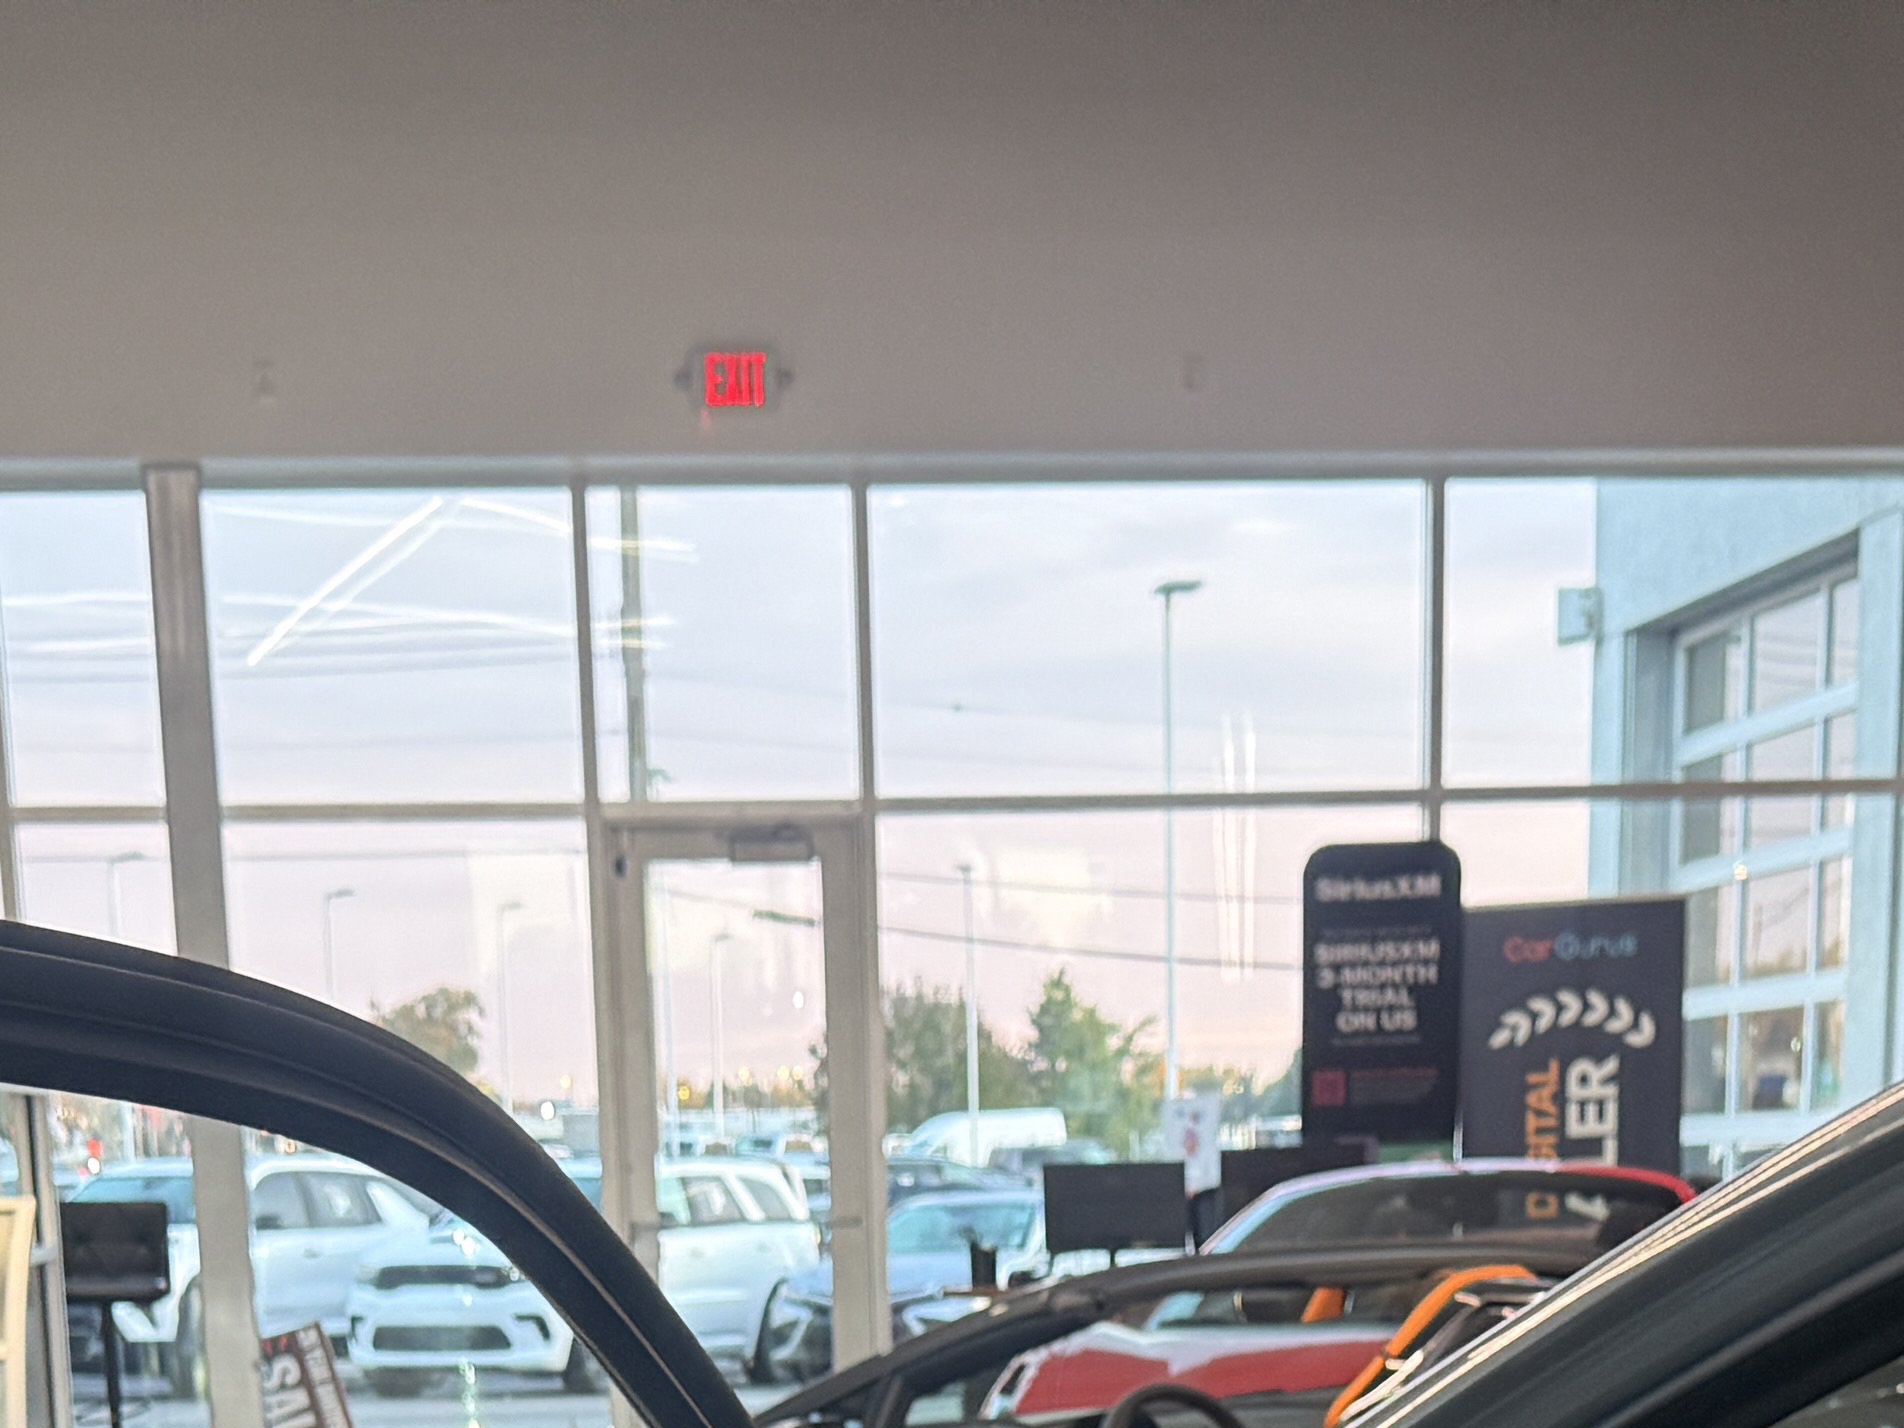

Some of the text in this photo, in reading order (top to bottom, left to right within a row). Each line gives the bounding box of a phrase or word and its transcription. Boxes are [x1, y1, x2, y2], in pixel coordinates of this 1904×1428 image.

[704, 351, 767, 408] EXIT
[1503, 930, 1638, 964] CarGurus
[1316, 962, 1439, 990] 3-MONTH
